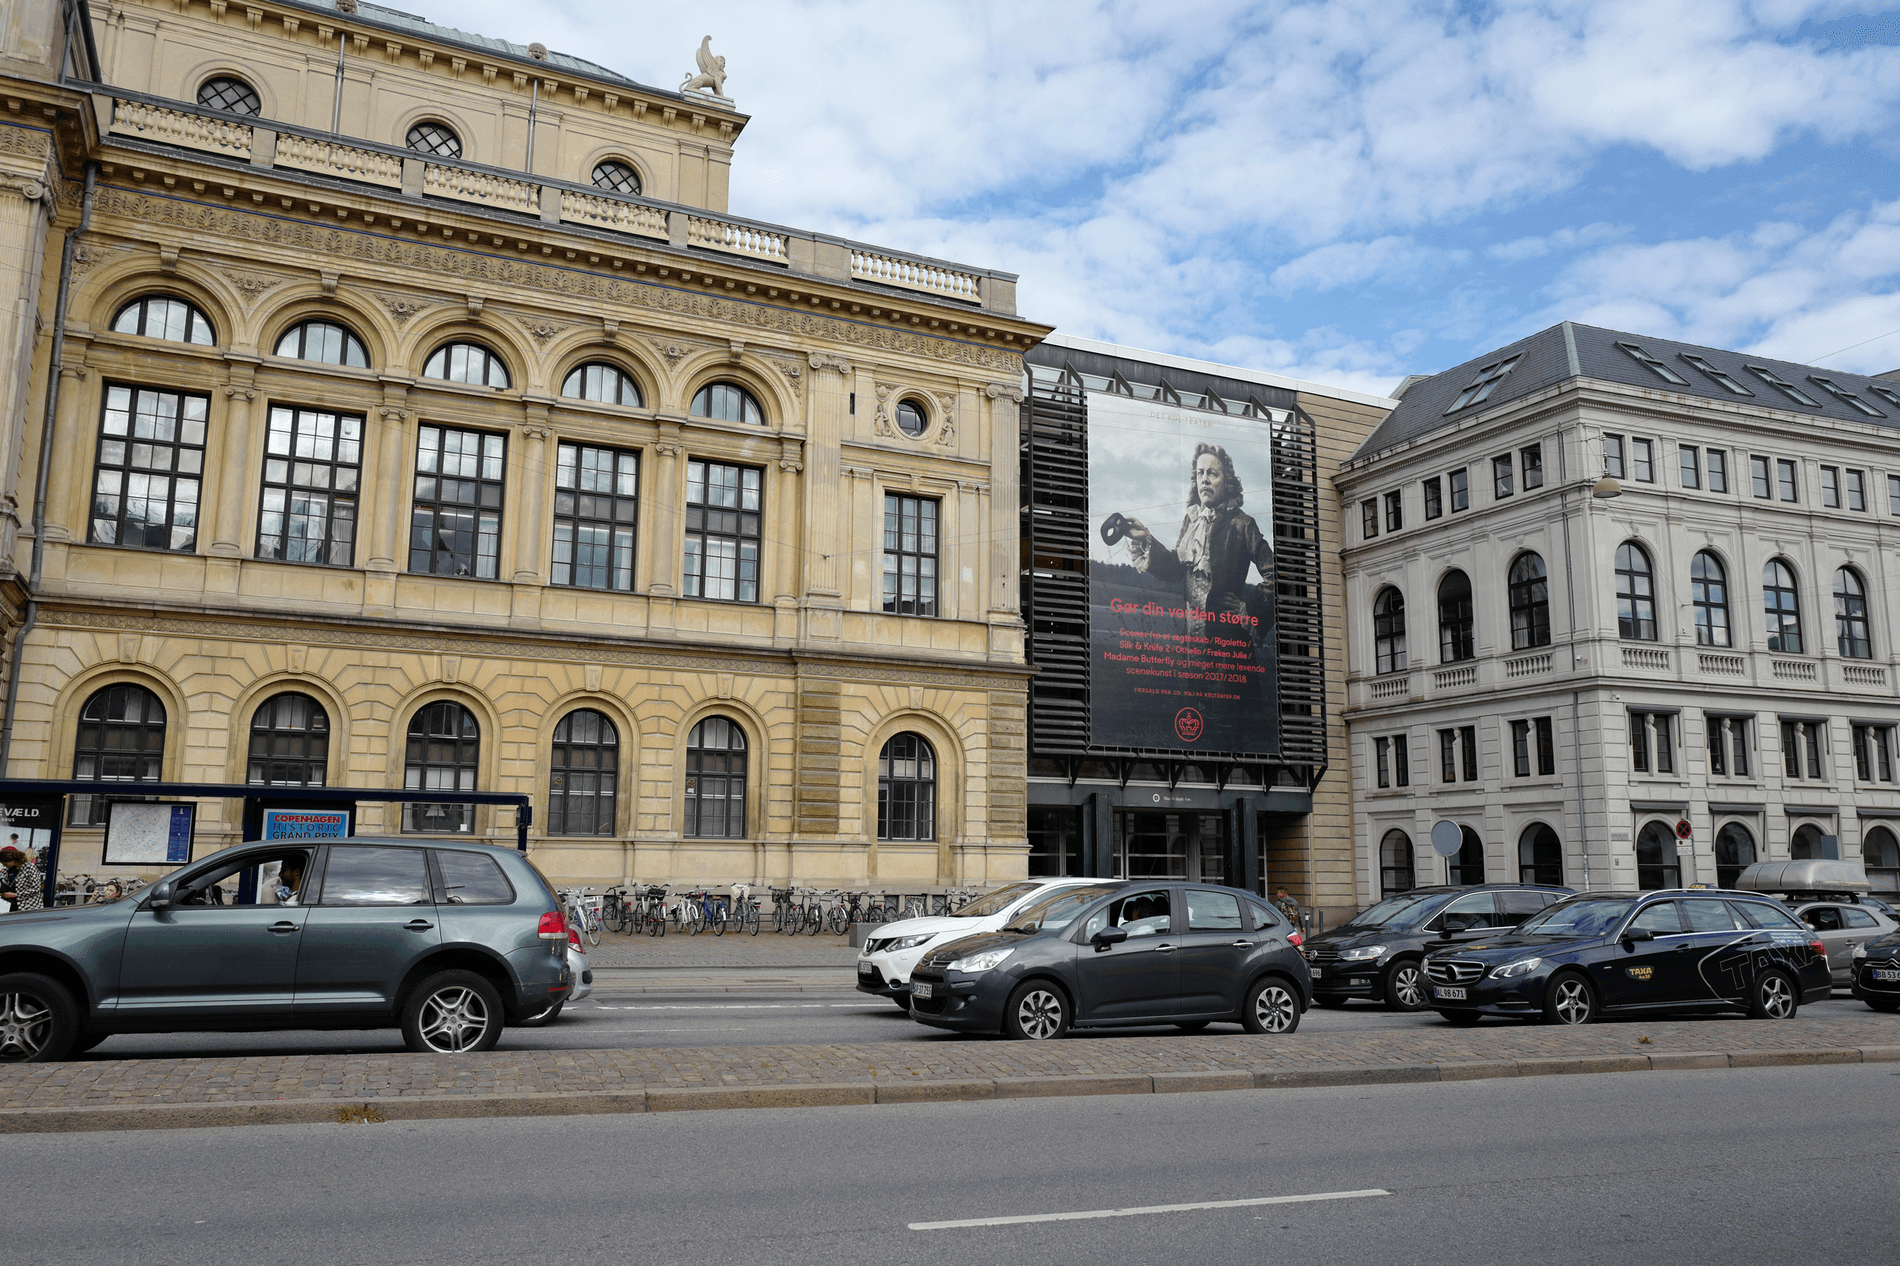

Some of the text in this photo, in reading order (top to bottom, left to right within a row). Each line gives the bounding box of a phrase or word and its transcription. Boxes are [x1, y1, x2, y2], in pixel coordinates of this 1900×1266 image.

[1150, 411, 1165, 420] DET
[1111, 598, 1259, 626] Gør din verden større
[1120, 628, 1147, 637] Scener
[1150, 631, 1161, 639] fra
[1215, 637, 1247, 647] Rigoletto
[1120, 641, 1134, 649] Silk
[1144, 643, 1164, 651] Knife
[1232, 651, 1248, 659] Julie
[1104, 652, 1139, 662] Madame
[1141, 655, 1175, 666] Butterfly
[1177, 660, 1187, 668] og
[1189, 661, 1214, 669] meget
[1237, 663, 1267, 673] levende
[1127, 668, 1172, 677] scenekunst
[1205, 672, 1247, 683] 2017/2018
[274, 814, 341, 824] COPENHAGEN
[273, 823, 340, 832] HISTORIC
[272, 831, 311, 839] GRAND
[1629, 967, 1653, 975] TAXA
[1452, 989, 1465, 998] 671
